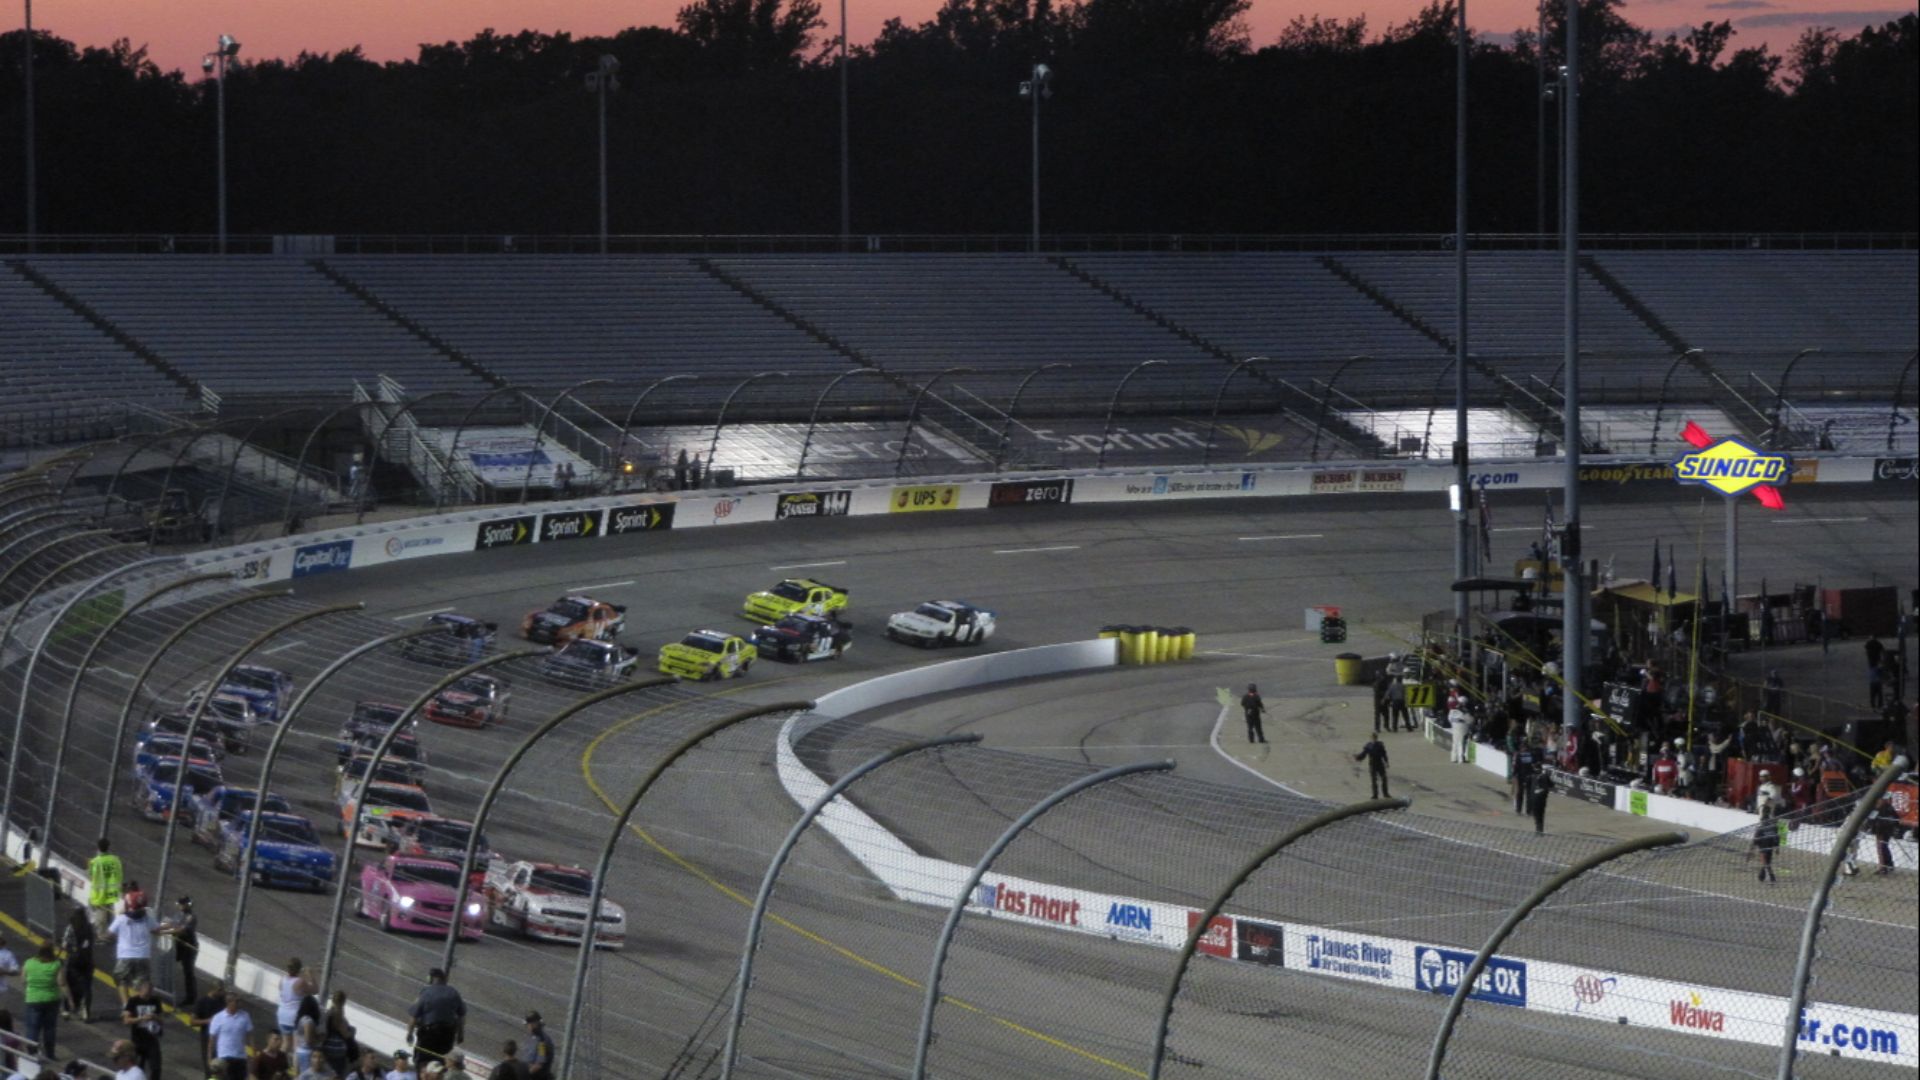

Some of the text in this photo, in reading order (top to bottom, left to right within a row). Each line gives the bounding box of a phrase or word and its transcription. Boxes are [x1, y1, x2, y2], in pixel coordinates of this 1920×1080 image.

[1034, 427, 1219, 453] Sprint
[1681, 457, 1784, 479] SUNOCO
[913, 490, 937, 505] UPS
[1025, 486, 1059, 501] zero
[548, 517, 580, 541] Sprint
[616, 511, 648, 533] Sprint
[484, 524, 515, 548] Sprint
[1030, 893, 1081, 926] mart
[1106, 902, 1152, 931] MRN
[1322, 936, 1393, 965] James River
[1495, 967, 1521, 997] OX
[1670, 999, 1724, 1032] Wawa
